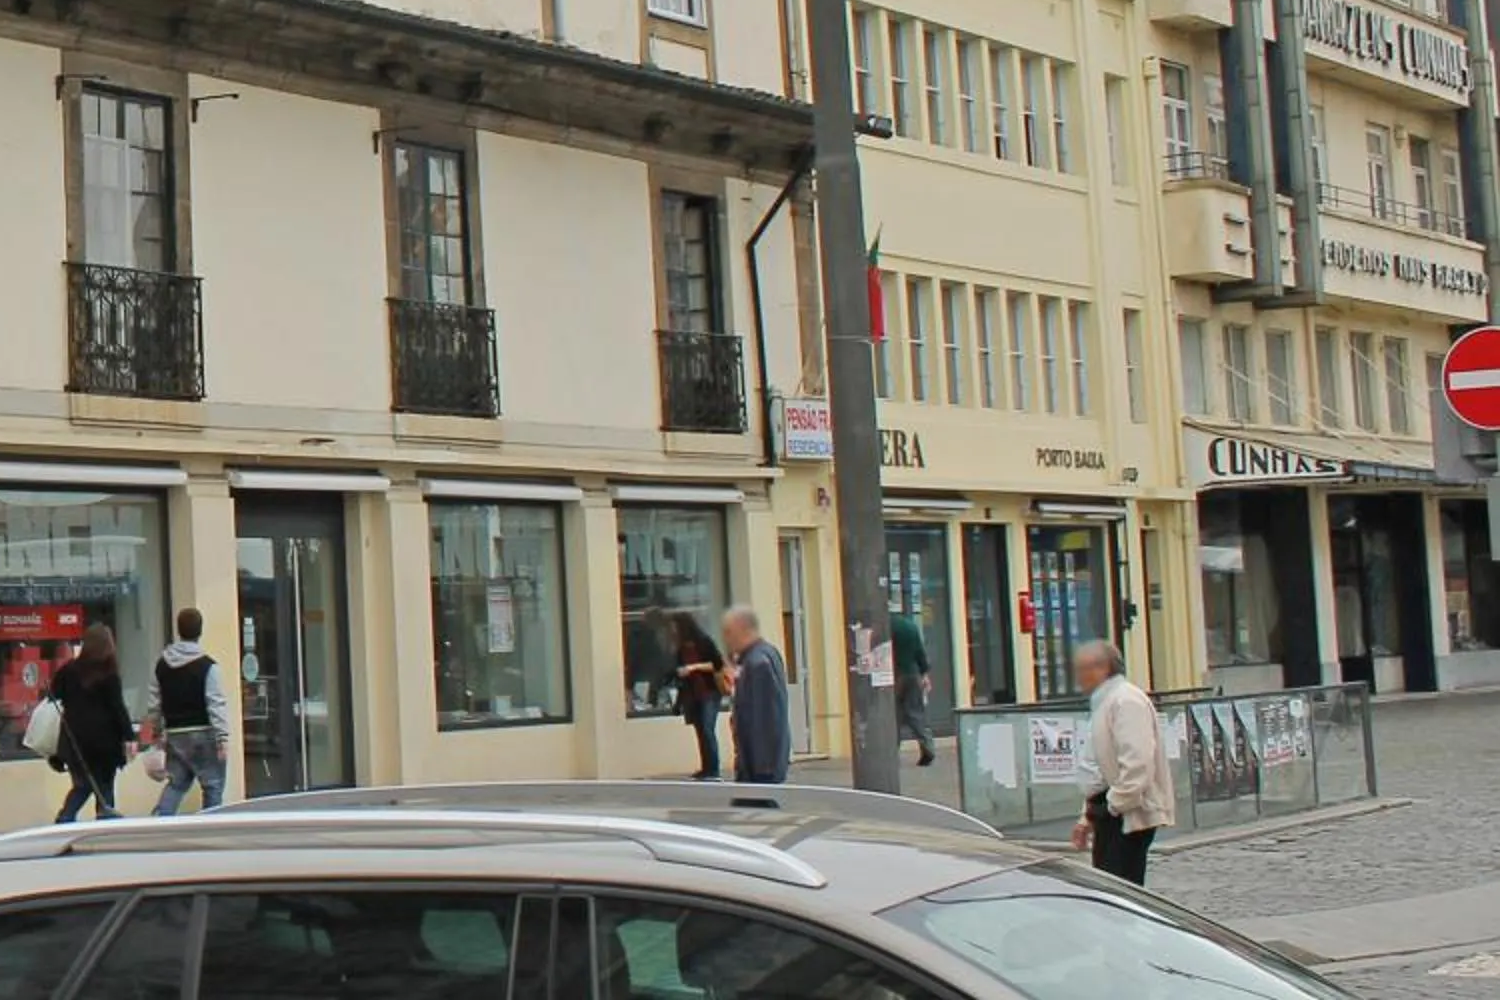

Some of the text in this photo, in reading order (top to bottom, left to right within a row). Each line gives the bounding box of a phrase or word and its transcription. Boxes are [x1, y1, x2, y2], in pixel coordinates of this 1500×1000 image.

[877, 428, 925, 469] ERA
[1036, 447, 1106, 469] PORTO BAIXA
[1208, 437, 1337, 476] CUNHAS
